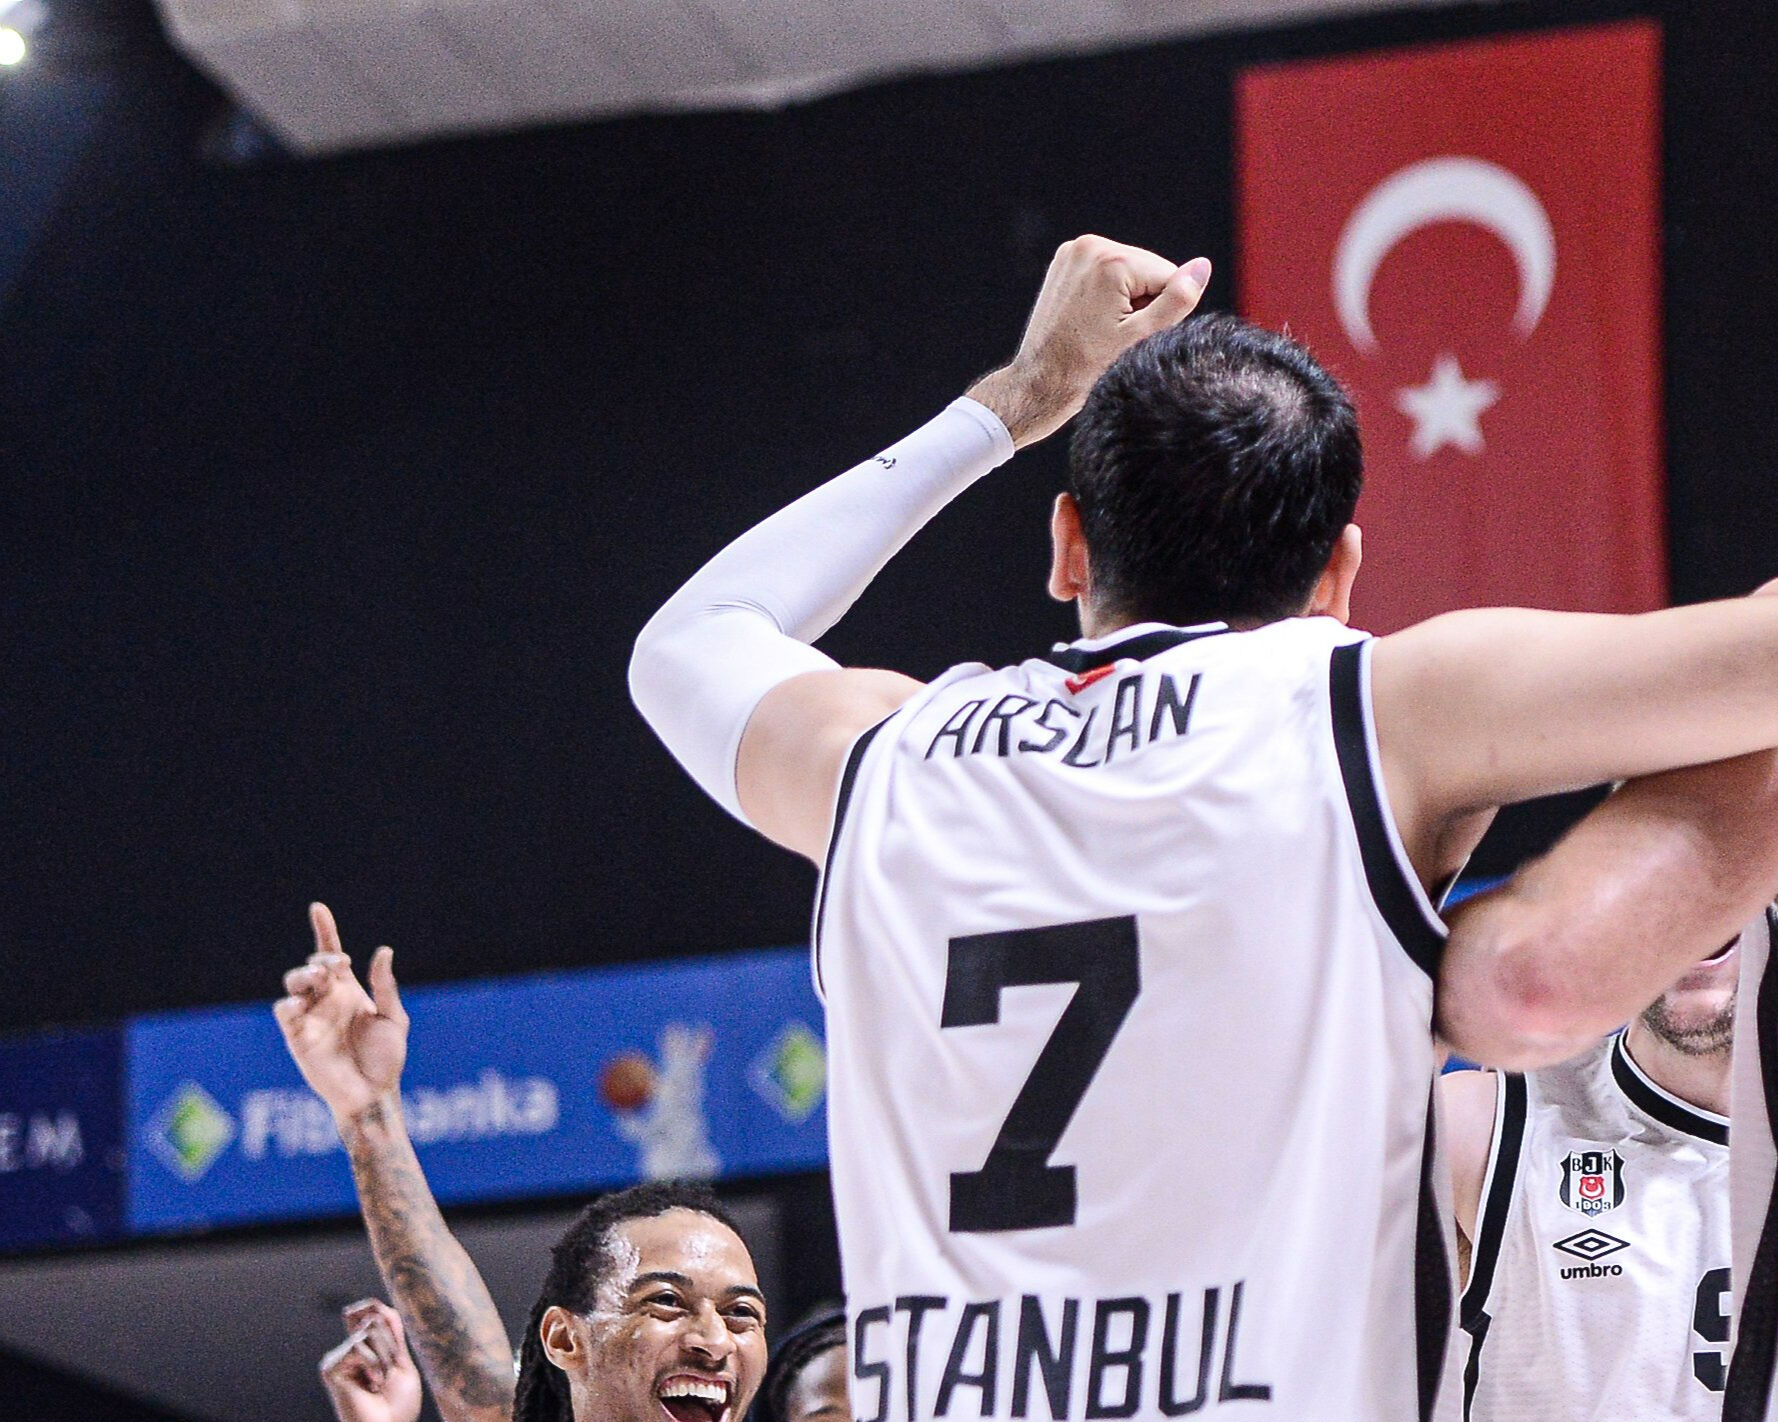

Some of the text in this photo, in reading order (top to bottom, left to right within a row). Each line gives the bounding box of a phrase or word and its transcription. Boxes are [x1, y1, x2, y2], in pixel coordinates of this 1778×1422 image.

[924, 672, 1202, 768] ARSLAN
[941, 914, 1141, 1233] 7
[1560, 1263, 1623, 1280] umbro
